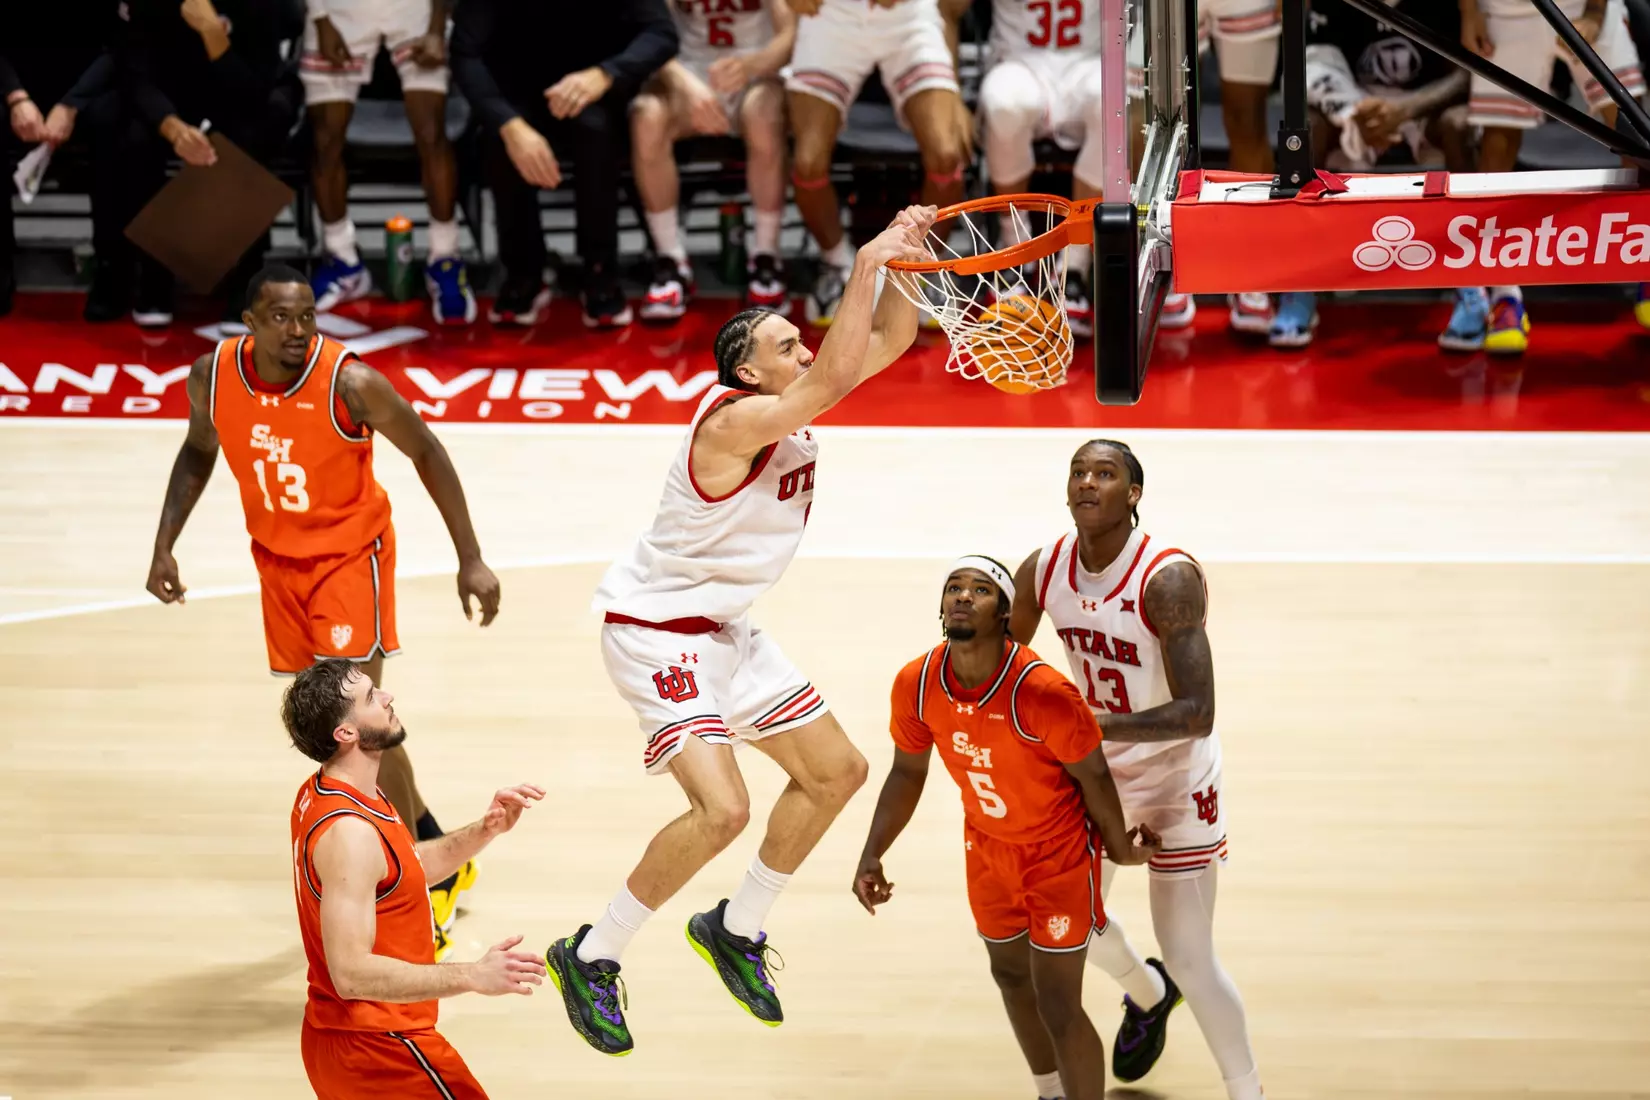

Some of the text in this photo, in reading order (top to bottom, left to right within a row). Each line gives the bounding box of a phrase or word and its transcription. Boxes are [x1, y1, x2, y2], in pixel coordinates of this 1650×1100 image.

[708, 16, 735, 48] 6
[1026, 0, 1083, 49] 32
[1443, 214, 1589, 269] State
[404, 367, 719, 401] VIEW
[253, 459, 310, 513] 13
[777, 461, 816, 501] UT
[1057, 627, 1142, 667] UTAH
[1083, 659, 1132, 714] 13
[966, 770, 1007, 818] 5
